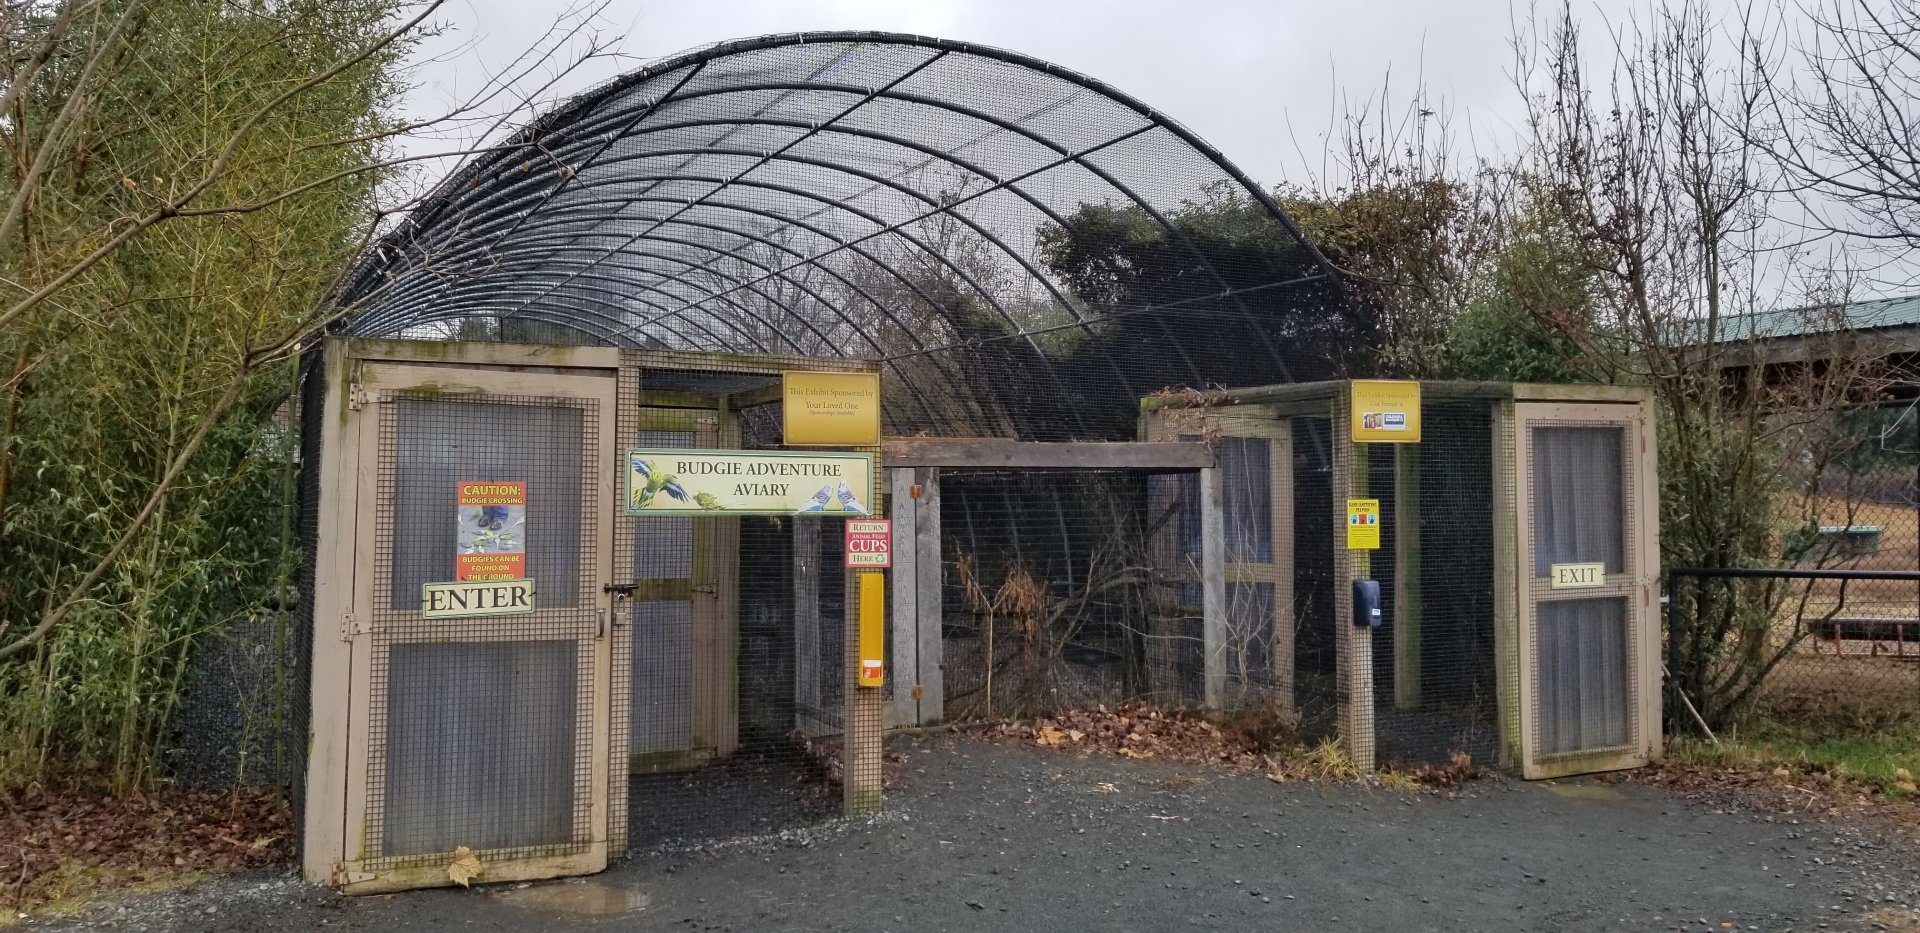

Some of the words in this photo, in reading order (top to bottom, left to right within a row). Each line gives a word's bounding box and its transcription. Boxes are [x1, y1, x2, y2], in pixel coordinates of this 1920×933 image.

[789, 387, 803, 395] This
[805, 388, 829, 396] Exhibit
[830, 389, 864, 398] Sponsored
[865, 389, 874, 398] by
[805, 401, 821, 409] Your
[844, 402, 859, 410] One
[676, 461, 743, 475] BUDGIE
[745, 463, 842, 477] ADVENTURE
[463, 485, 521, 495] CAUTION:
[733, 483, 791, 496] AVIARY
[853, 523, 884, 531] RETURN
[849, 539, 888, 552] CUPS
[853, 554, 874, 562] HERE
[1559, 568, 1597, 584] EXIT
[428, 586, 529, 611] ENTER
